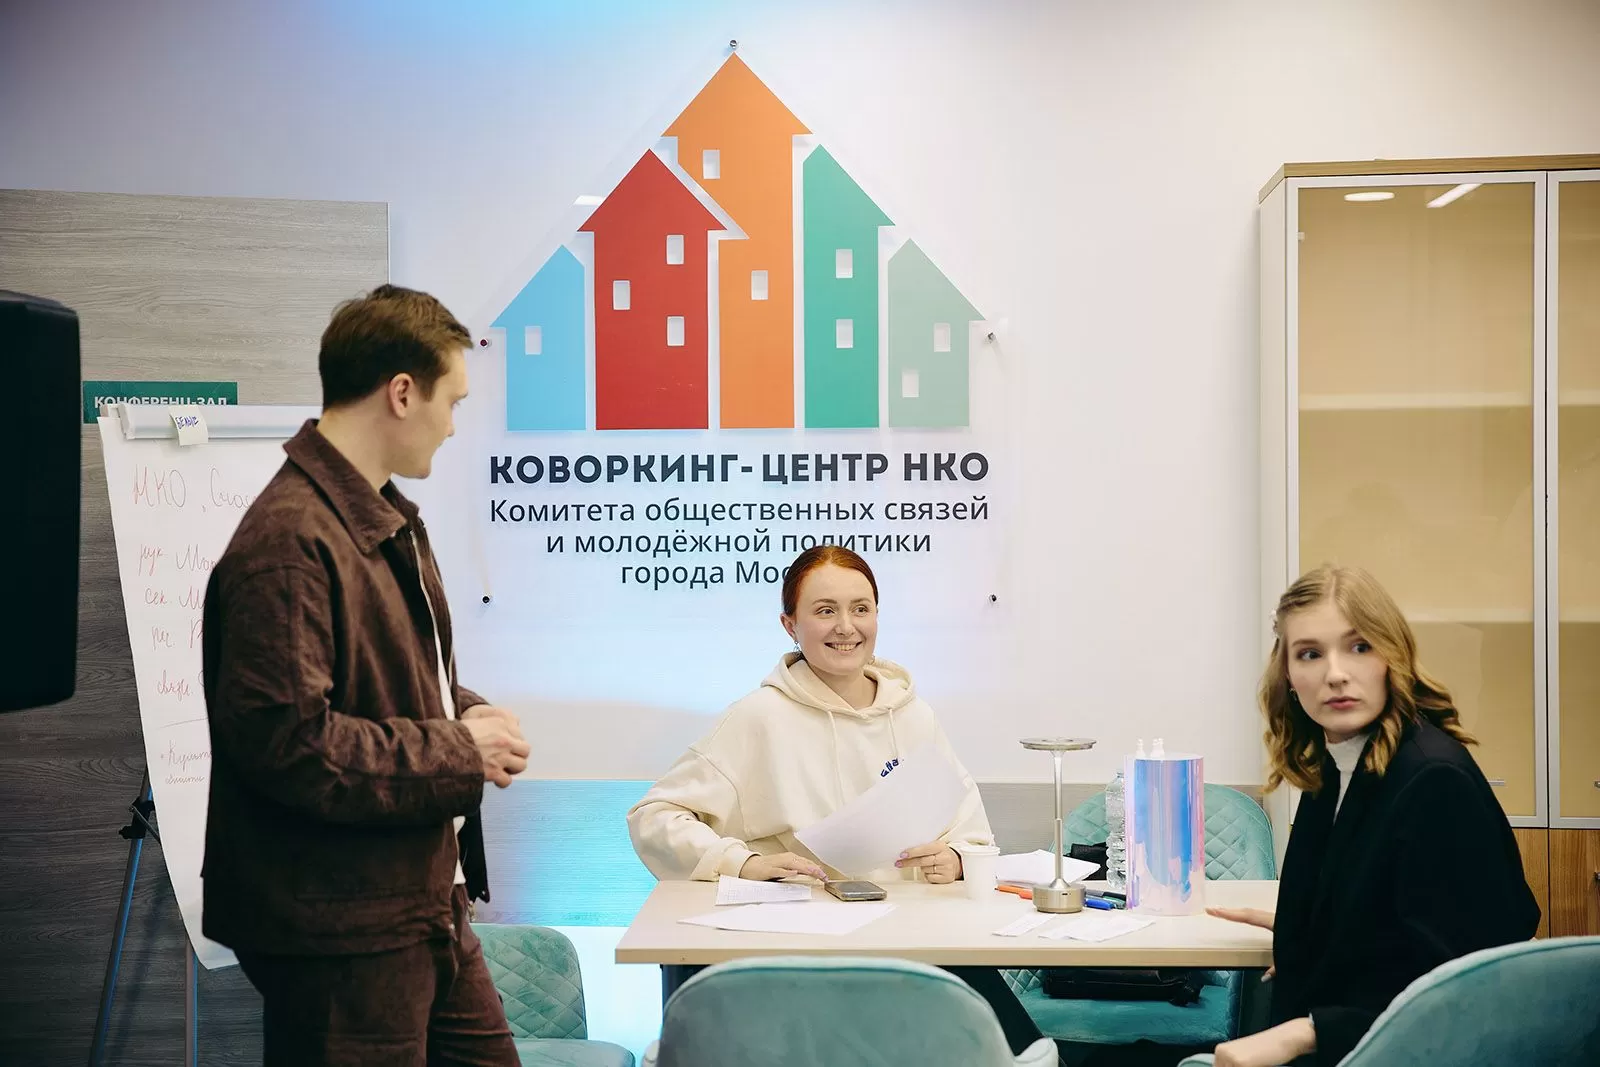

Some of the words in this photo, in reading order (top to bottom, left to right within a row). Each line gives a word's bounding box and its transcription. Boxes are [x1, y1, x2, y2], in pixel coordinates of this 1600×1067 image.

[491, 454, 888, 484] КОВОРКИНГ-ЦЕНТР
[904, 453, 988, 481] НКО
[491, 499, 635, 523] Комитета
[645, 497, 875, 527] общественных
[885, 494, 989, 521] связей
[547, 535, 564, 553] и
[575, 527, 770, 557] молодёжной
[782, 534, 931, 553] политики
[622, 560, 724, 590] города
